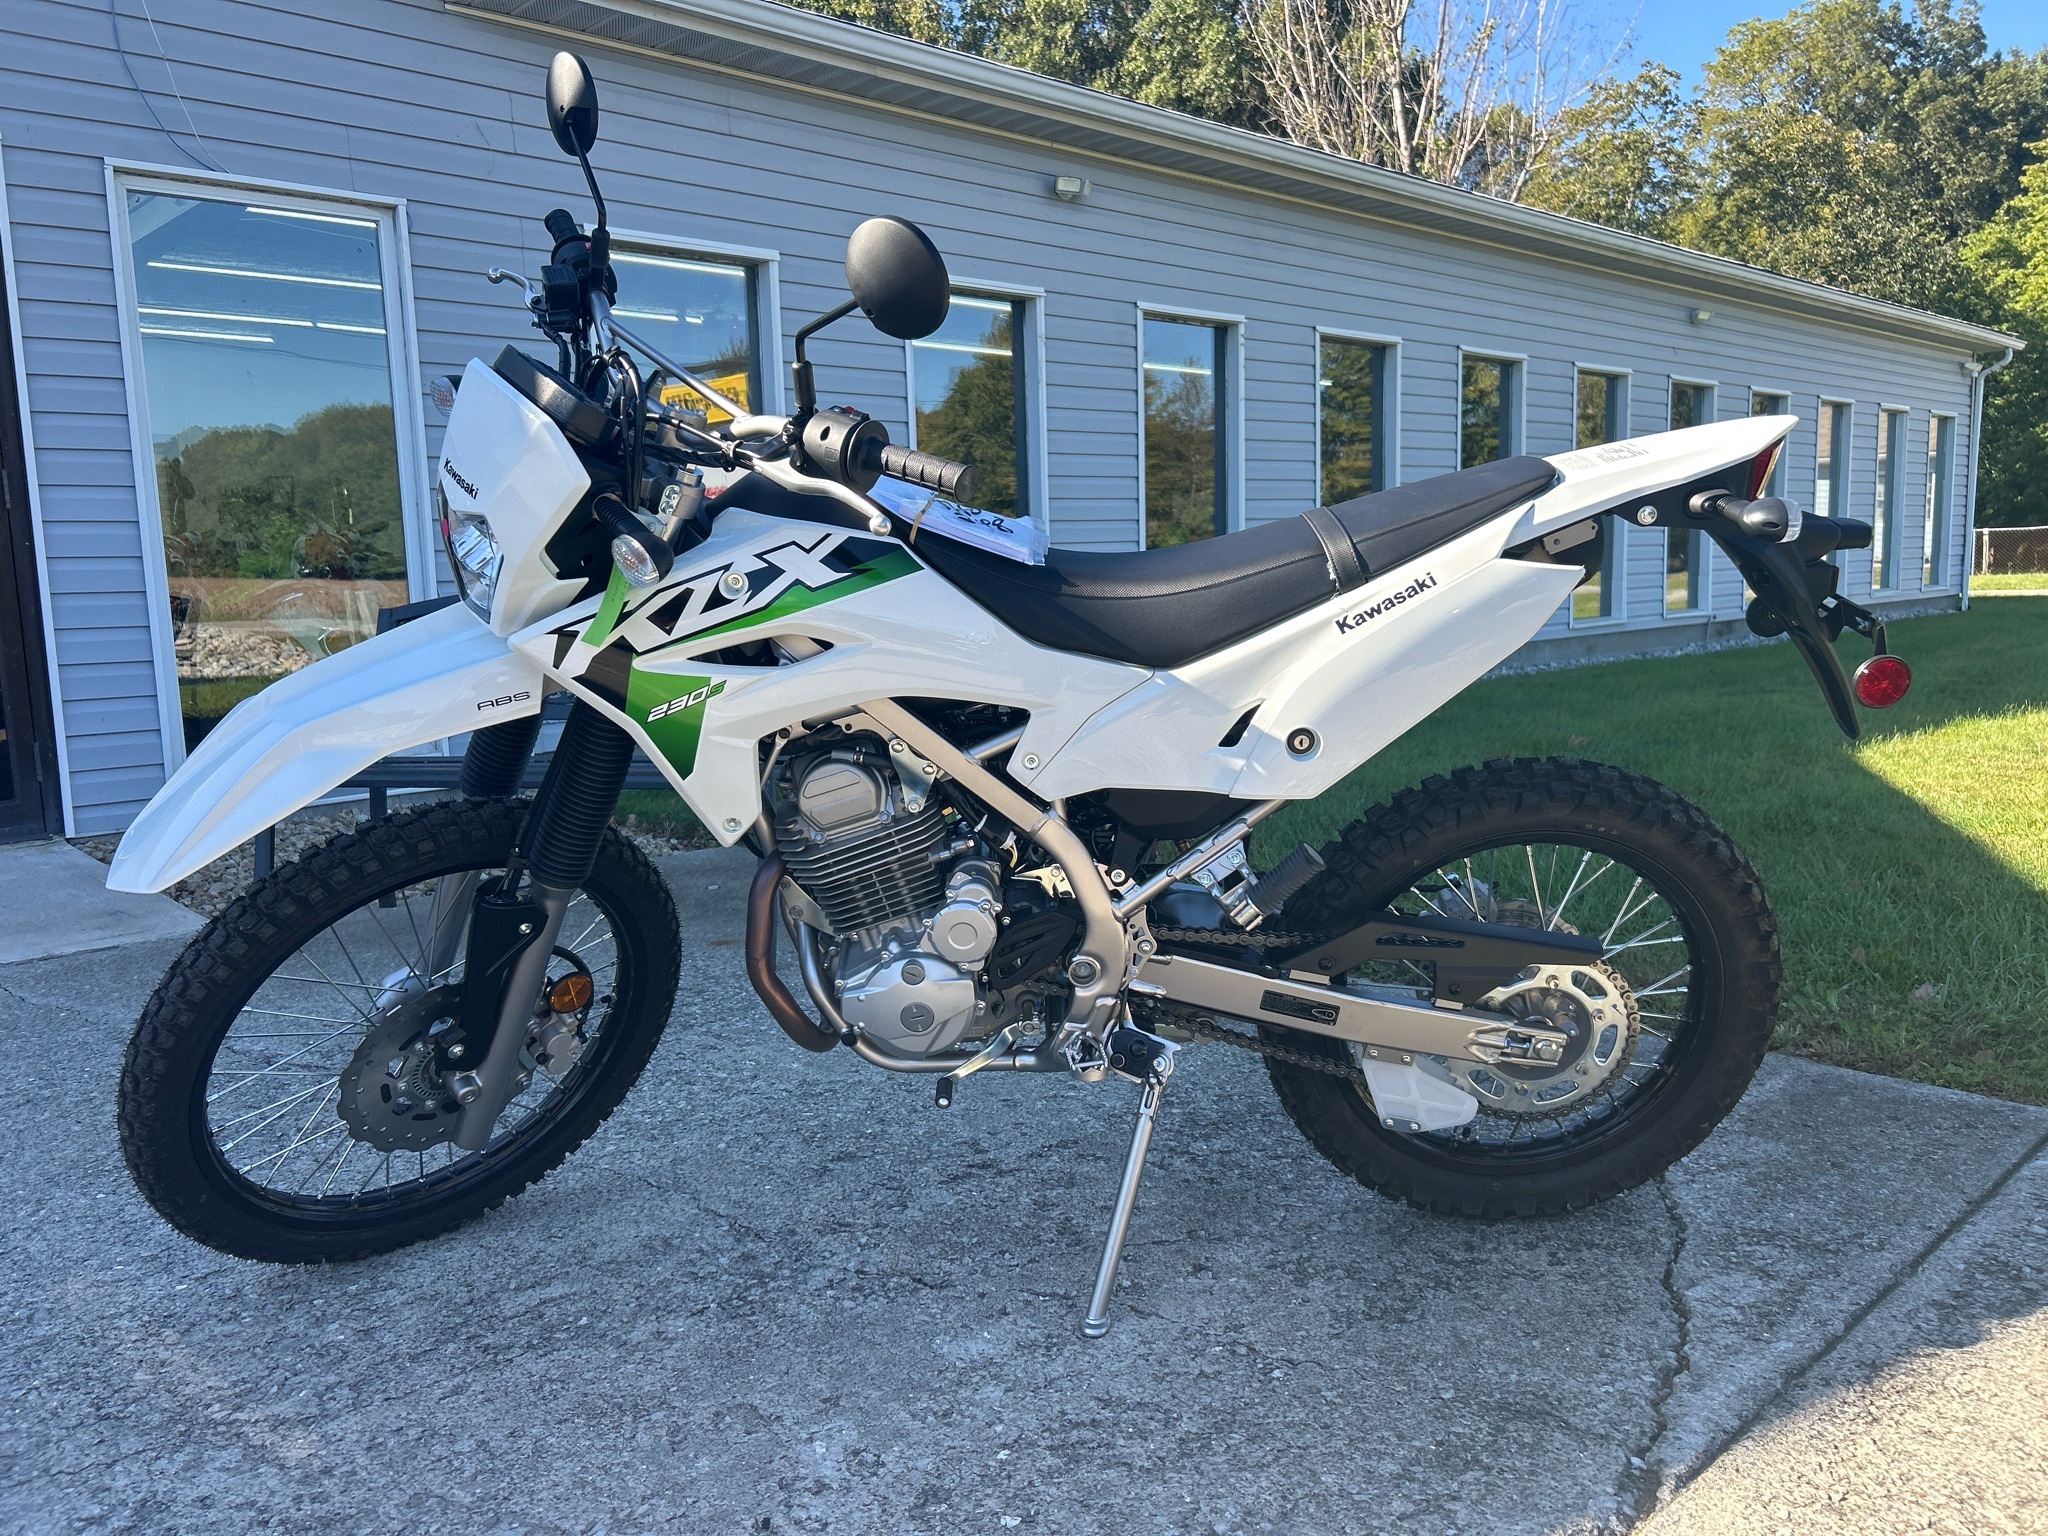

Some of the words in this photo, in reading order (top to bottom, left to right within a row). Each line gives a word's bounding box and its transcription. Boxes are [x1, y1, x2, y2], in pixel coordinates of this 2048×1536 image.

[443, 457, 479, 500] Kawasaki
[1335, 571, 1438, 635] Kawasaki
[477, 691, 531, 711] ABS
[645, 679, 728, 724] 230S
